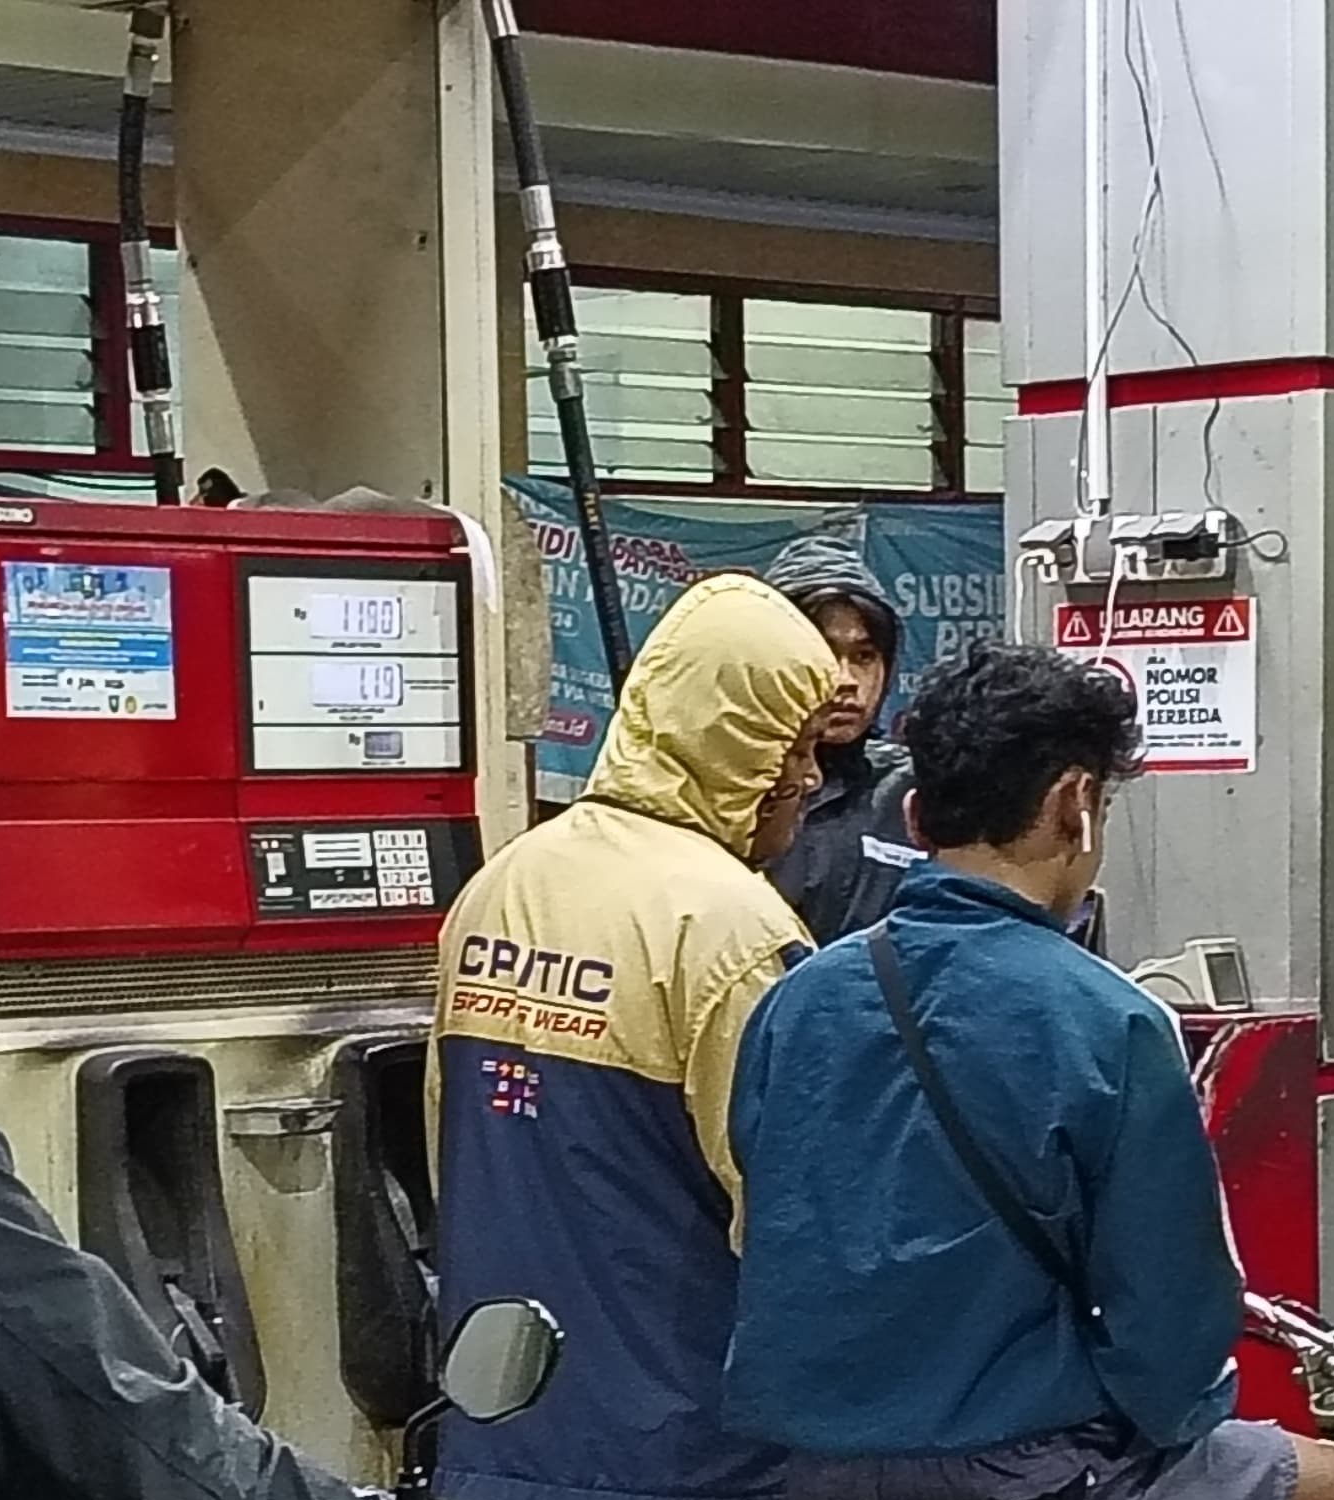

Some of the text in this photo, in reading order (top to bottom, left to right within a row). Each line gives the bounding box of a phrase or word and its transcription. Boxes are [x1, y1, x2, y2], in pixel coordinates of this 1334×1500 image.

[1146, 667, 1218, 685] NOMOR
[1146, 688, 1200, 705] POLISI
[1146, 708, 1222, 725] BERBEDA
[458, 935, 613, 1003] CRITIC
[534, 1009, 607, 1040] WEAR
